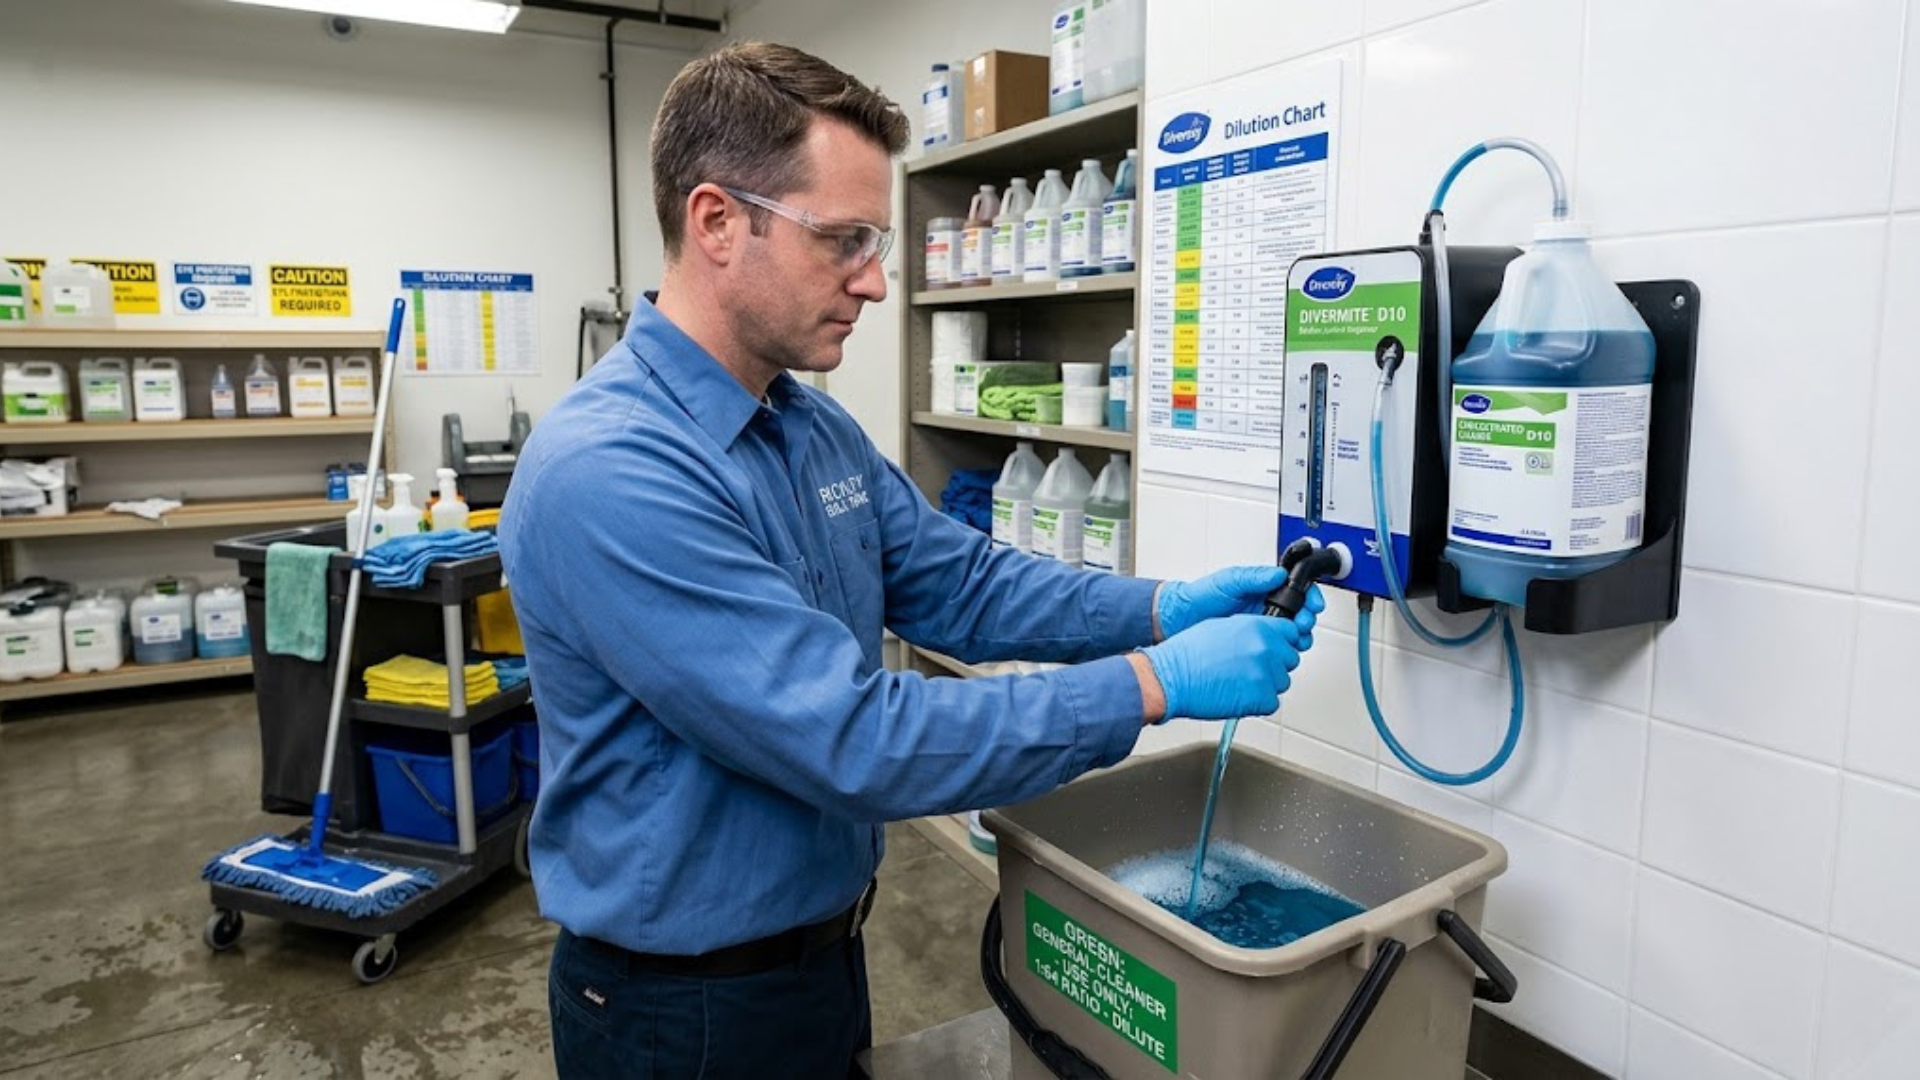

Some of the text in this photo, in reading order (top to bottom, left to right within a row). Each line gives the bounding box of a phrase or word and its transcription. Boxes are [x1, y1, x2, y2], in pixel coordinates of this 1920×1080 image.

[1224, 101, 1326, 139] Dilution Chart
[273, 269, 346, 284] CAUTION
[280, 299, 342, 311] REQUIRED
[1377, 305, 1407, 322] D10
[1525, 430, 1552, 442] D10
[1062, 959, 1090, 989] USE
[1096, 964, 1167, 1021] CLEANER
[1035, 958, 1060, 986] 1:64
[1061, 975, 1101, 1014] RATIO
[1111, 1012, 1166, 1061] DILUTE
